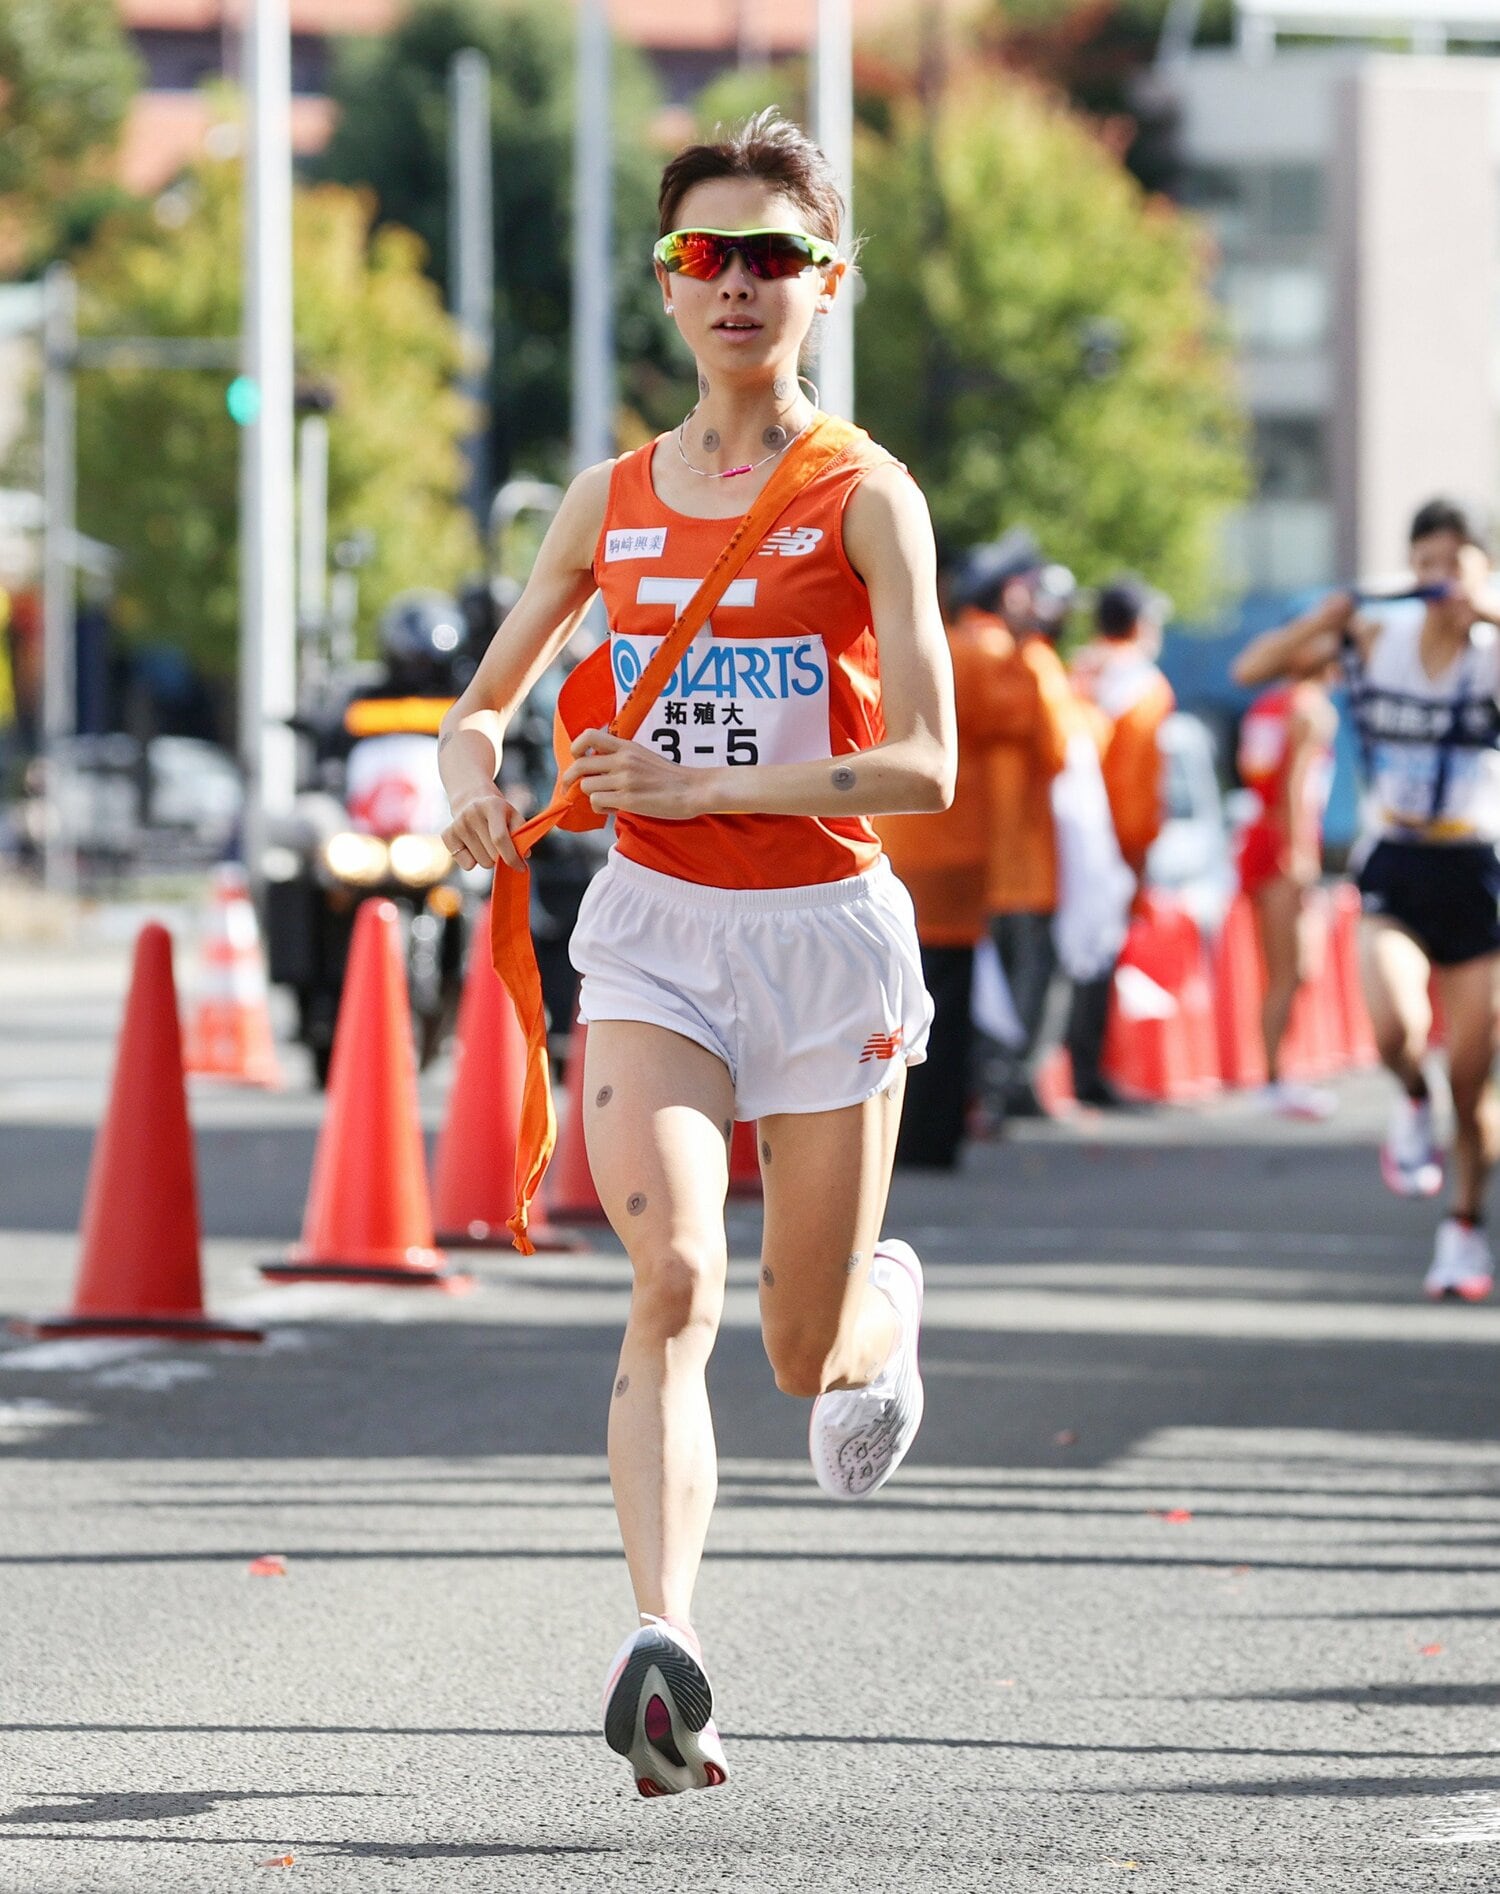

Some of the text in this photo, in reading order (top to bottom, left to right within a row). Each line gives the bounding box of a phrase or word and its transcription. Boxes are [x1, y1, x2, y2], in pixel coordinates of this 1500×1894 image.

[664, 701, 744, 725] 拓殖大
[651, 728, 758, 766] 3-5
